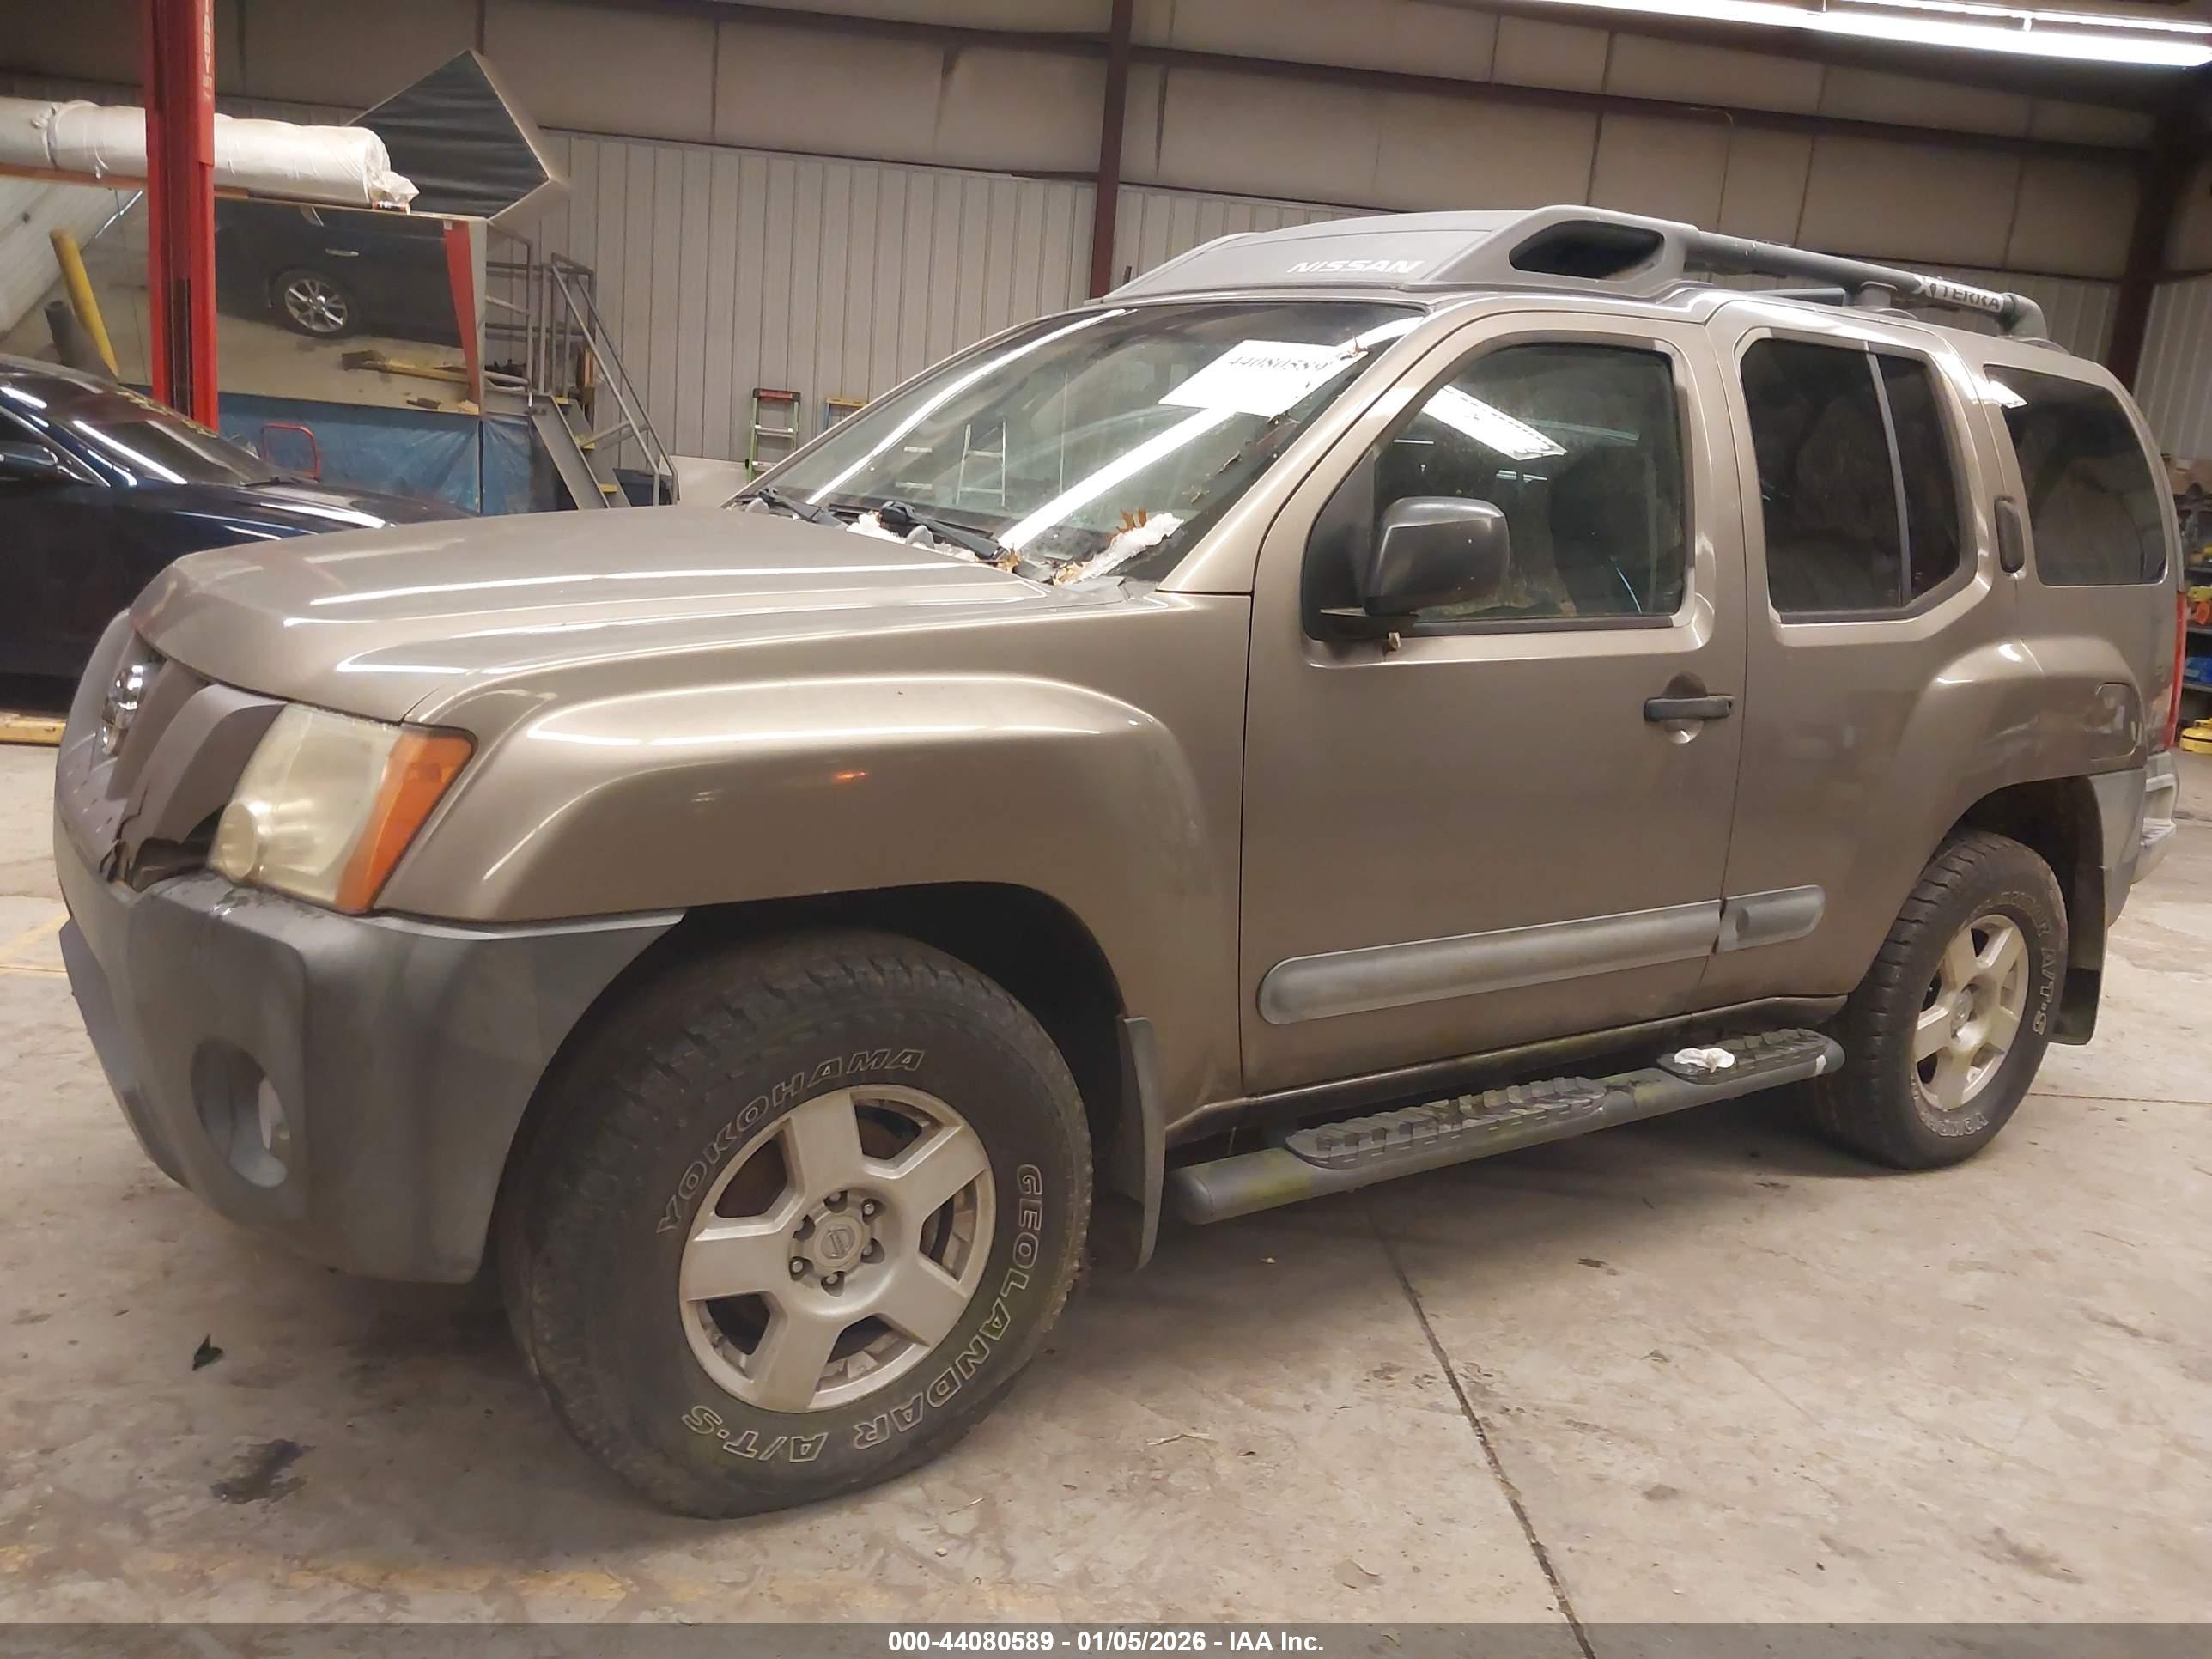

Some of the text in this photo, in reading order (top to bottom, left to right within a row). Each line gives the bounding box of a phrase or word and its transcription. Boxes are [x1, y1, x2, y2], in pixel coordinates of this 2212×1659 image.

[1286, 259, 1425, 274] NISSAN
[655, 1048, 926, 1235] YOKOHAMA
[853, 1164, 1044, 1450] GEOLANDAR
